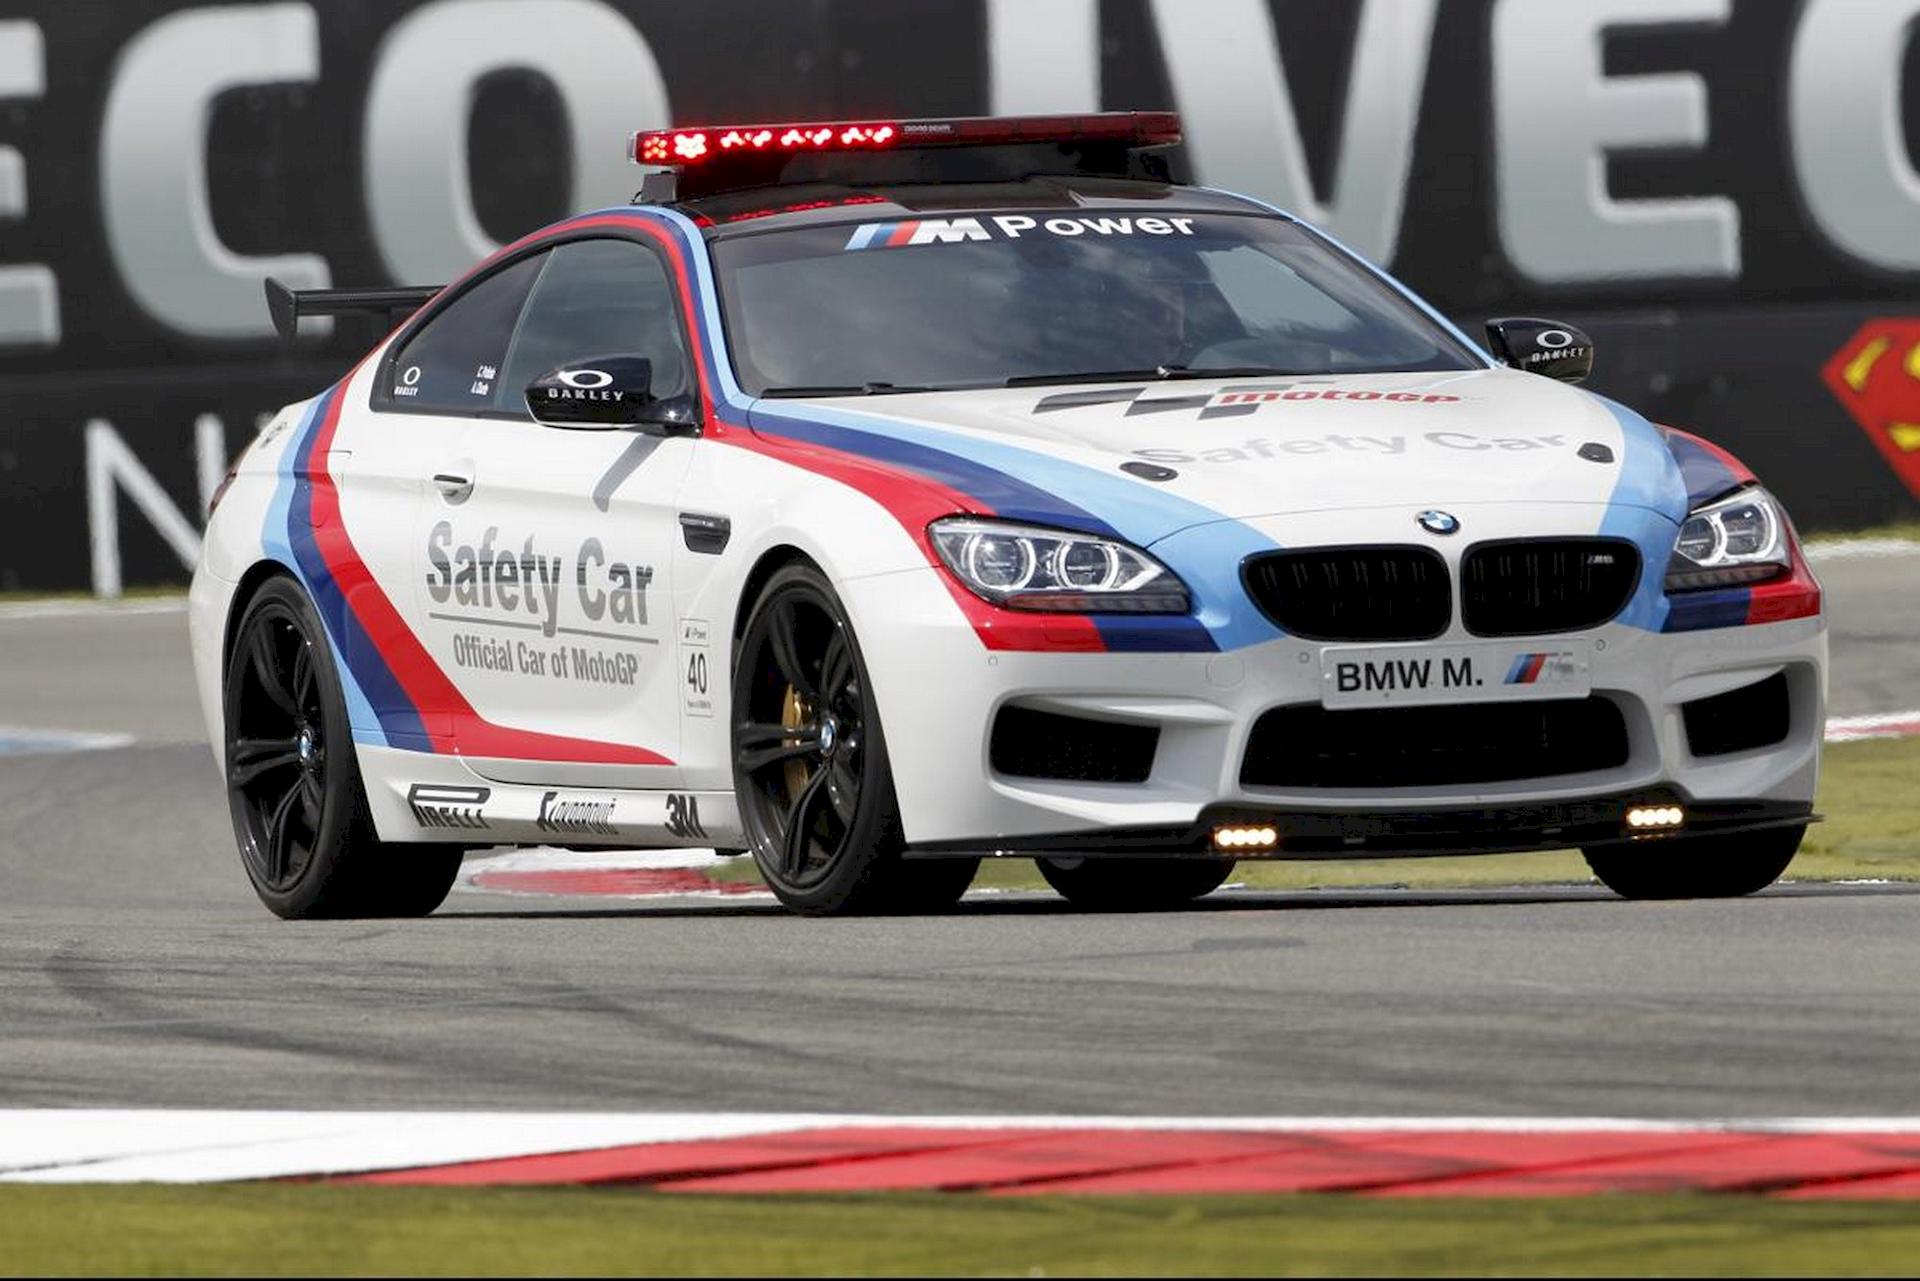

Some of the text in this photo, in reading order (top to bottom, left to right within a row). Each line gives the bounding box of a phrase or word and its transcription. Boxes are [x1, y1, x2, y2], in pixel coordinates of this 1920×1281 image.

[993, 214, 1193, 238] Power
[1532, 347, 1584, 363] OAKLEY
[548, 388, 624, 401] OAKLEY
[1130, 431, 1565, 464] Safety Car
[426, 521, 653, 638] Safety Car
[453, 633, 638, 685] Official Car of MotoGP
[687, 652, 708, 694] 40
[1337, 657, 1484, 692] BMW M.
[407, 783, 491, 829] PIRELLI
[664, 793, 708, 839] 3M
